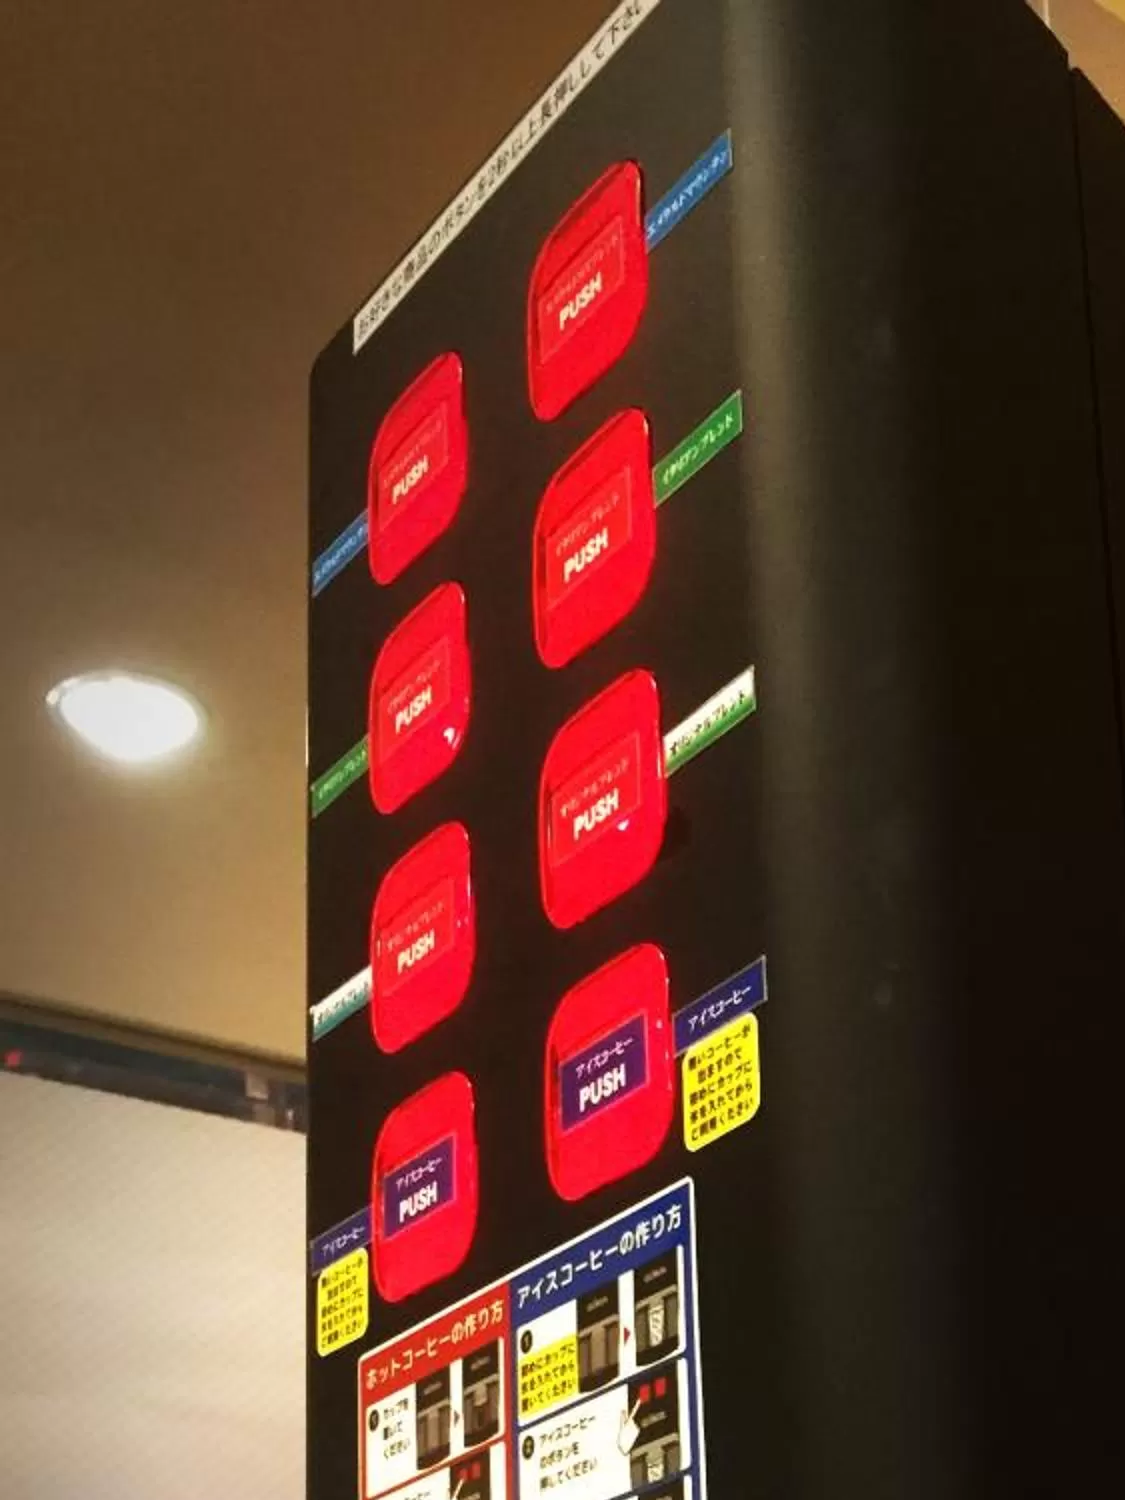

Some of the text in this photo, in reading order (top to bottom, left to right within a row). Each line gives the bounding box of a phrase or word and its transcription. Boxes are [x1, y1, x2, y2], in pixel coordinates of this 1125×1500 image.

[560, 271, 602, 331] PUSH
[392, 453, 429, 505] PUSH
[564, 527, 608, 583] PUSH
[395, 683, 432, 735] PUSH
[573, 786, 619, 842] PUSH
[397, 928, 435, 976] PUSH
[688, 985, 752, 1034] アイスコーヒー
[575, 1035, 634, 1078] アイスコーヒー
[579, 1062, 626, 1112] PUSH
[399, 1181, 438, 1223] PUSH
[517, 1203, 682, 1309] アイスコーヒーの作り方
[366, 1299, 504, 1390] ホットコーヒーの作り方
[539, 1415, 597, 1447] アイスコーヒー
